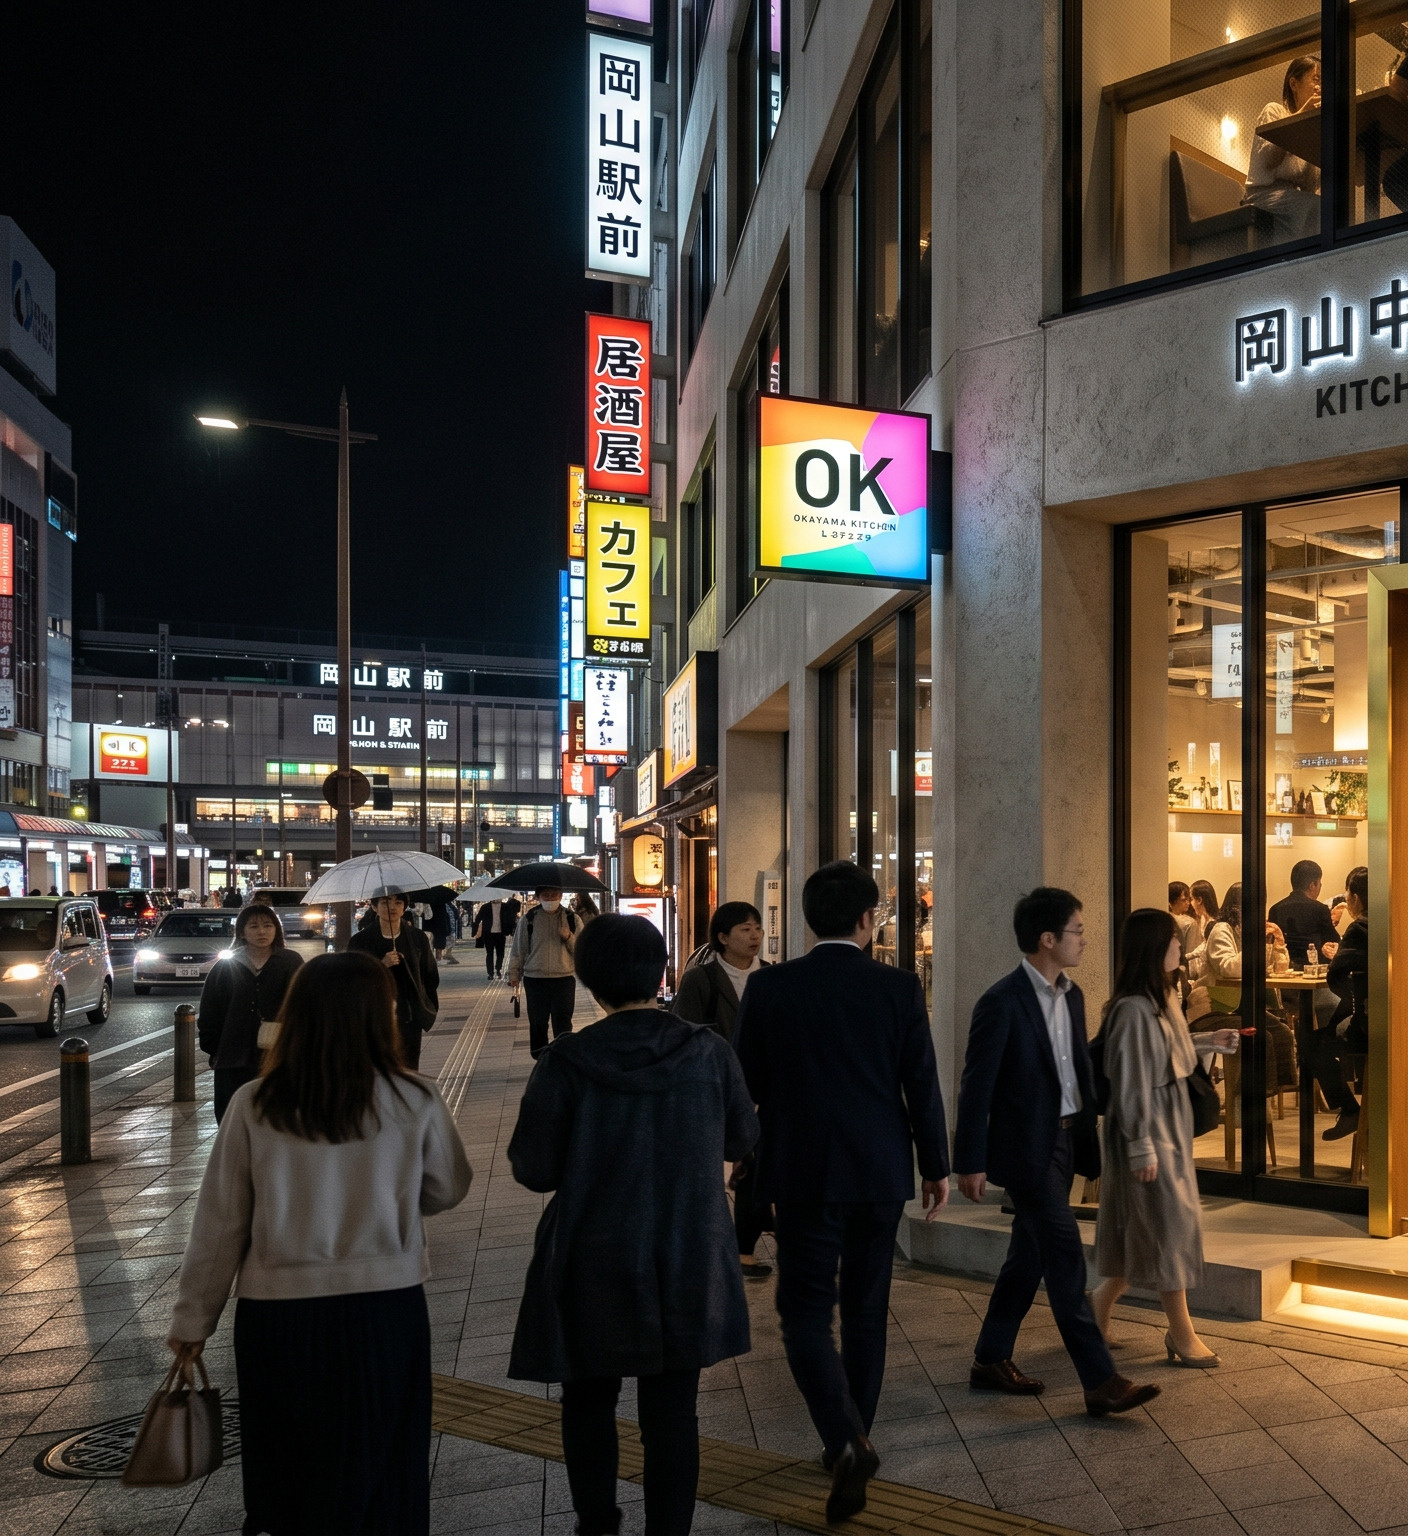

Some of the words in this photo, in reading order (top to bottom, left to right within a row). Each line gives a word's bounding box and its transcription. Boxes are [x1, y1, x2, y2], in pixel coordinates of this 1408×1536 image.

[596, 52, 642, 258] 岡山駅前
[595, 336, 644, 475] 居酒屋
[795, 449, 895, 516] OK
[793, 514, 847, 526] OKAYAMA
[600, 521, 637, 627] カフェ
[320, 663, 444, 690] 岡山駅前
[313, 714, 449, 740] 岡山駅前
